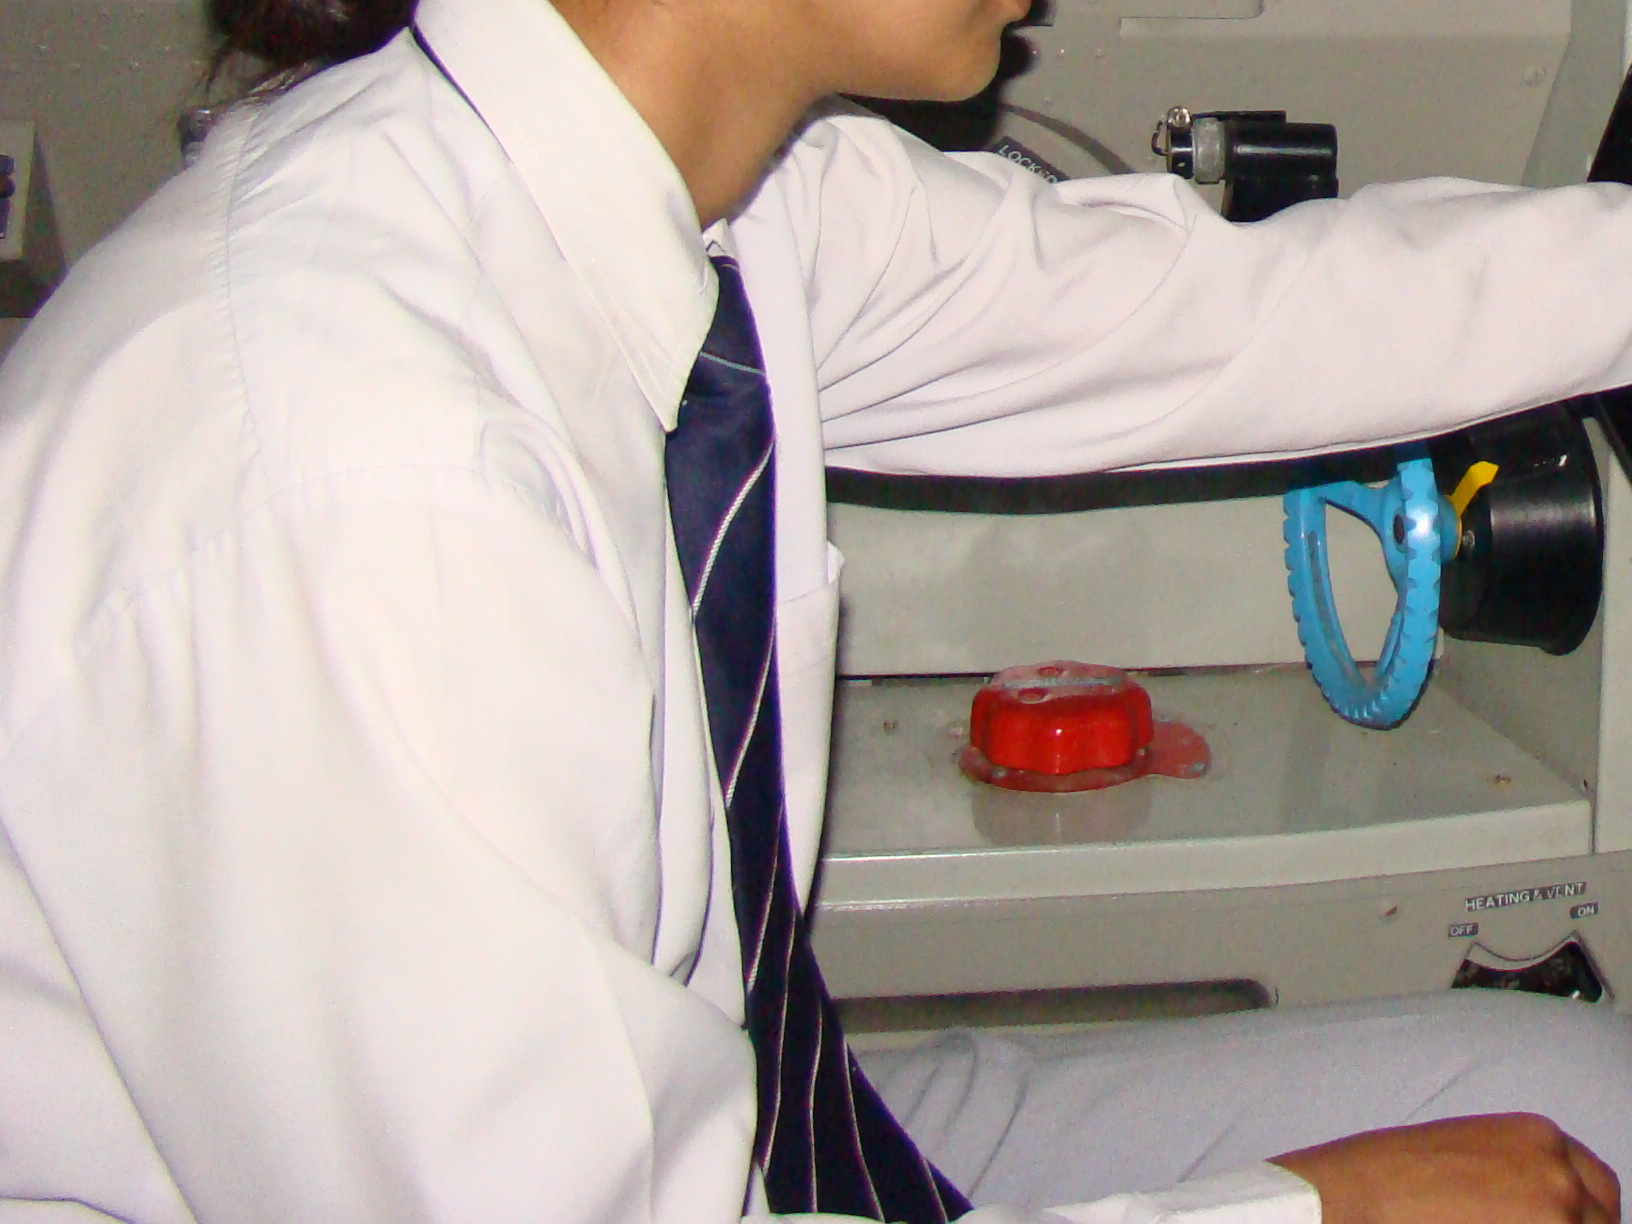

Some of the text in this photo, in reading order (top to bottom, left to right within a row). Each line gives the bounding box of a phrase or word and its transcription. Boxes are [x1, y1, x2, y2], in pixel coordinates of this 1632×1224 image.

[1465, 890, 1530, 911] HEATING
[1577, 905, 1595, 916] ON
[1450, 924, 1474, 936] OFF
